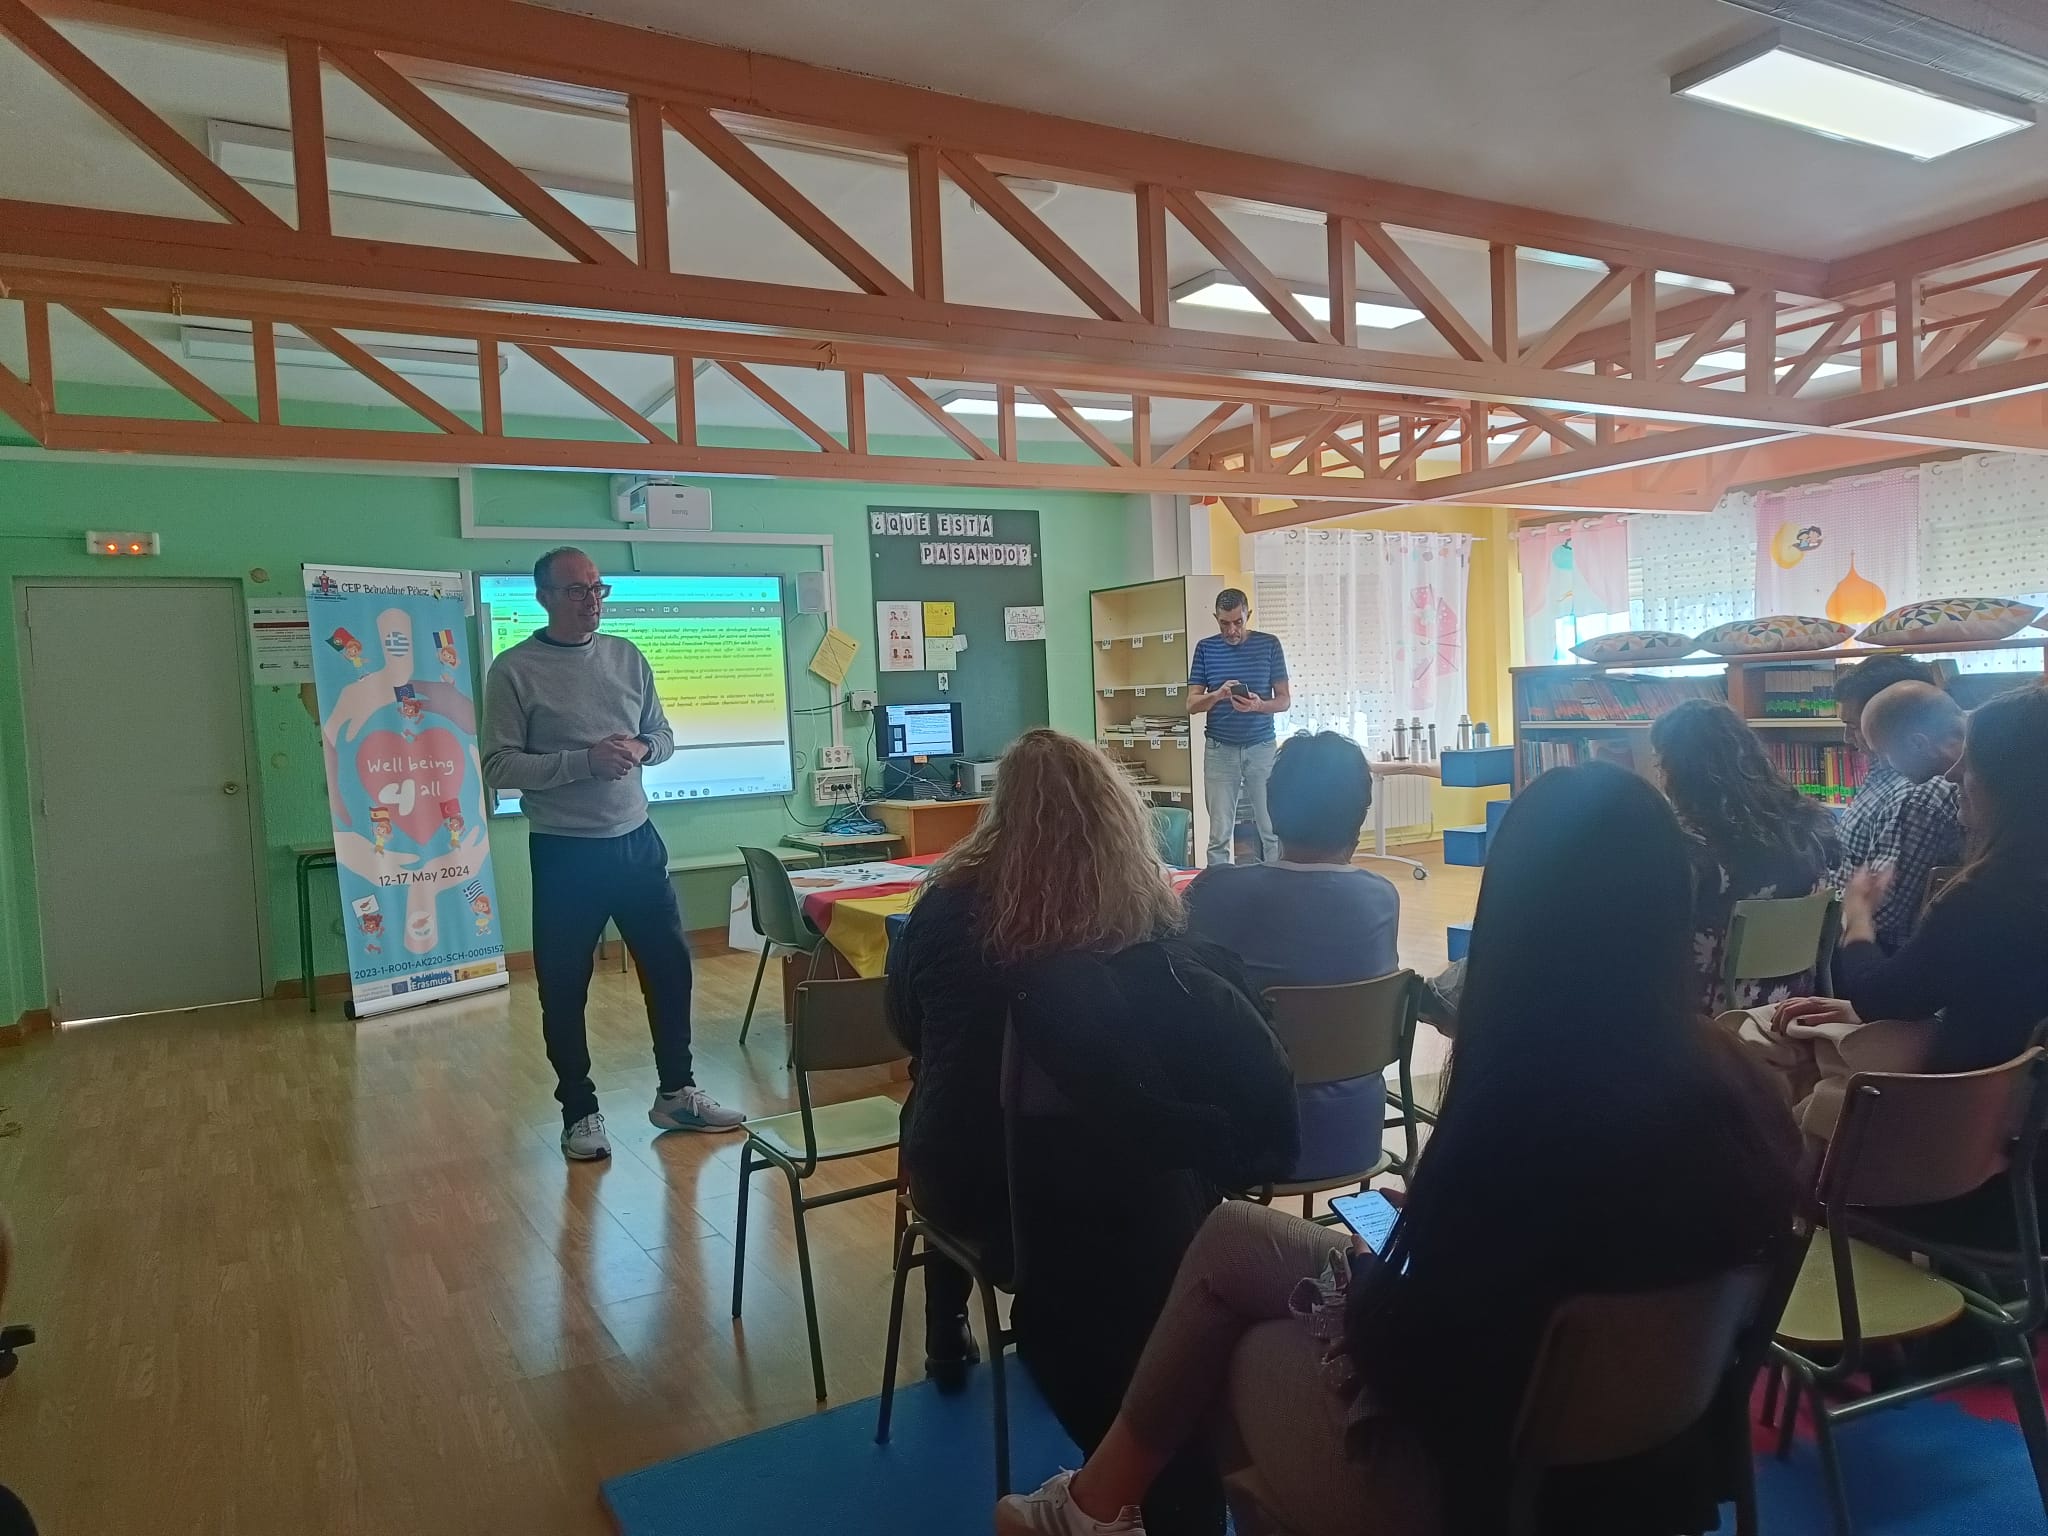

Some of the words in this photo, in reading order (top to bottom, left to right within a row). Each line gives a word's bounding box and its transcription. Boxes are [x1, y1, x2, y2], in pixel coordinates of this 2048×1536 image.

[941, 515, 991, 533] ESTÁ
[924, 547, 1028, 561] PASANDO?
[341, 583, 361, 593] CEIP
[367, 757, 402, 773] Well
[408, 755, 455, 776] being
[378, 778, 416, 816] 4
[420, 780, 441, 797] all
[379, 873, 409, 887] 12-17
[412, 869, 438, 883] May
[441, 865, 470, 879] 2024
